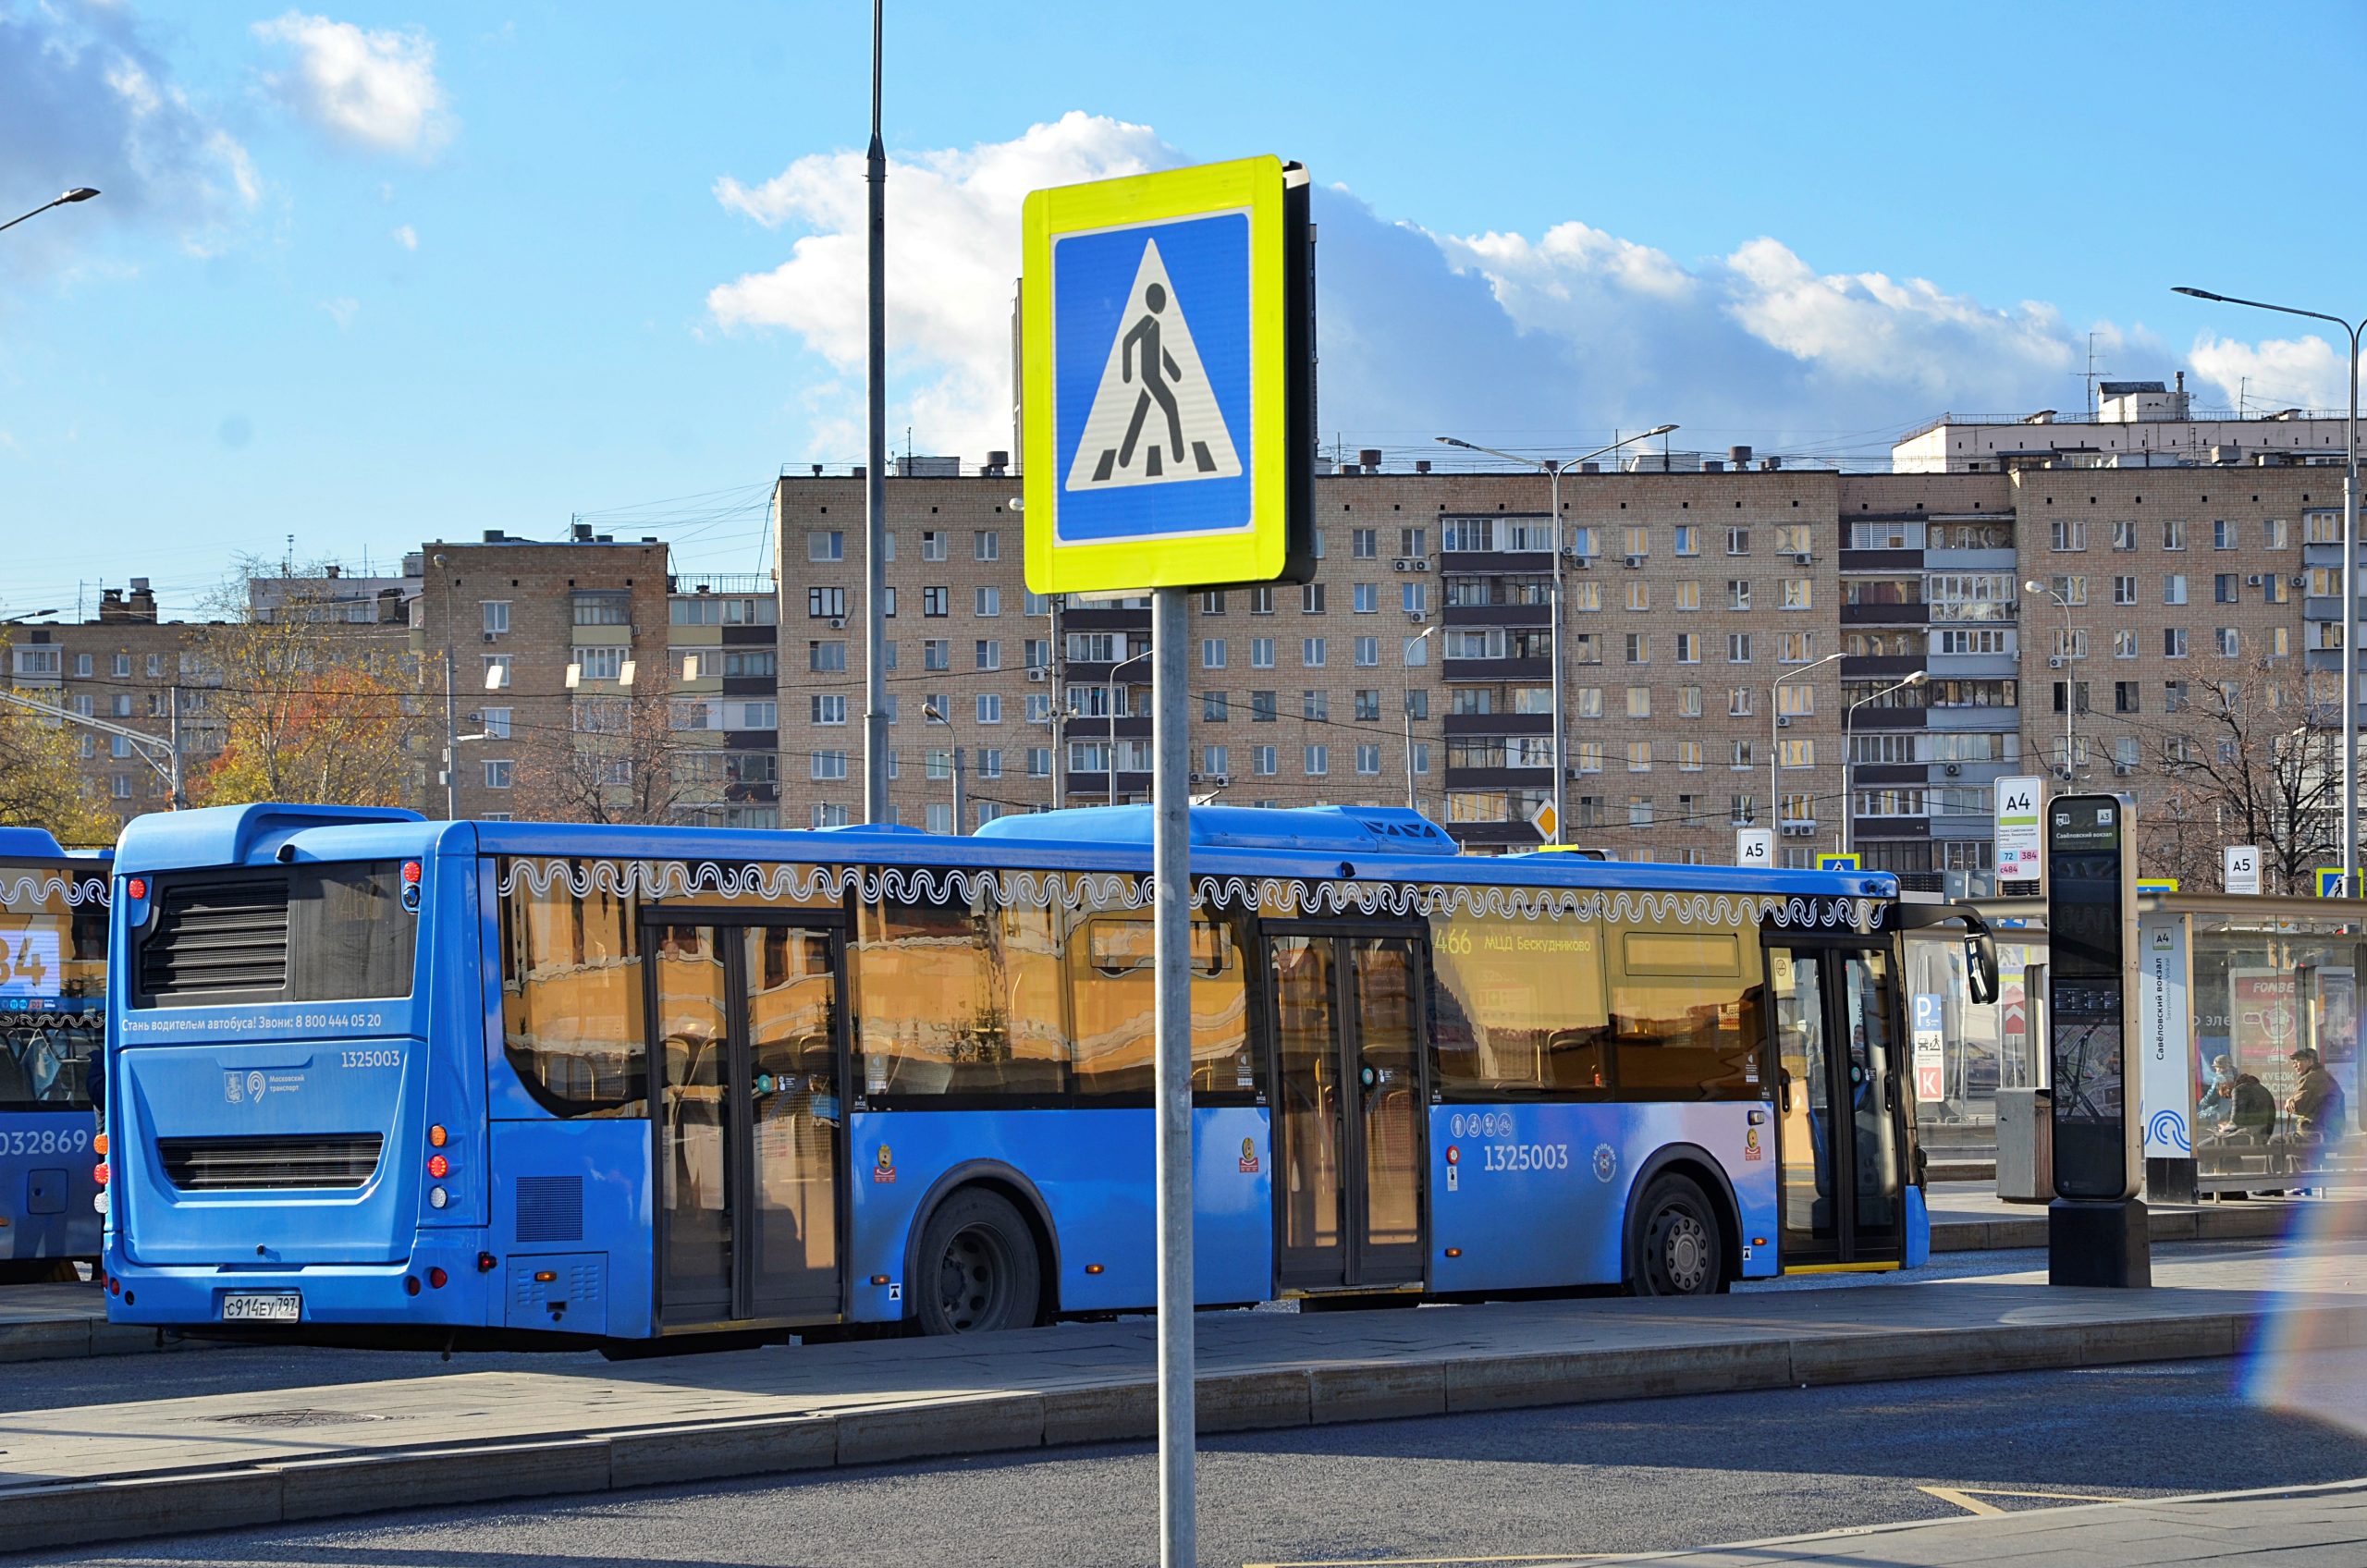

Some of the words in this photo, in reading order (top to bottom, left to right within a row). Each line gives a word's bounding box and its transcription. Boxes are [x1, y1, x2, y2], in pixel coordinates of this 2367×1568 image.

[2021, 851, 2037, 860] 384
[1435, 928, 1472, 954] 466
[1484, 936, 1513, 951] МЦД
[1517, 937, 1591, 952] Бескудниково
[122, 1019, 150, 1032] Стань
[152, 1020, 205, 1033] водителем
[207, 1016, 257, 1032] автобуса!
[259, 1016, 293, 1029] Звони:
[296, 1015, 302, 1027] 8
[305, 1014, 325, 1028] 800
[328, 1014, 349, 1027] 444
[351, 1014, 365, 1027] 05
[367, 1014, 381, 1027] 20
[2156, 995, 2165, 1060] Савёловский
[341, 1050, 400, 1068] 1325003
[269, 1074, 305, 1083] Московский
[1484, 1145, 1568, 1171] 1325003
[277, 1297, 296, 1312] 797
